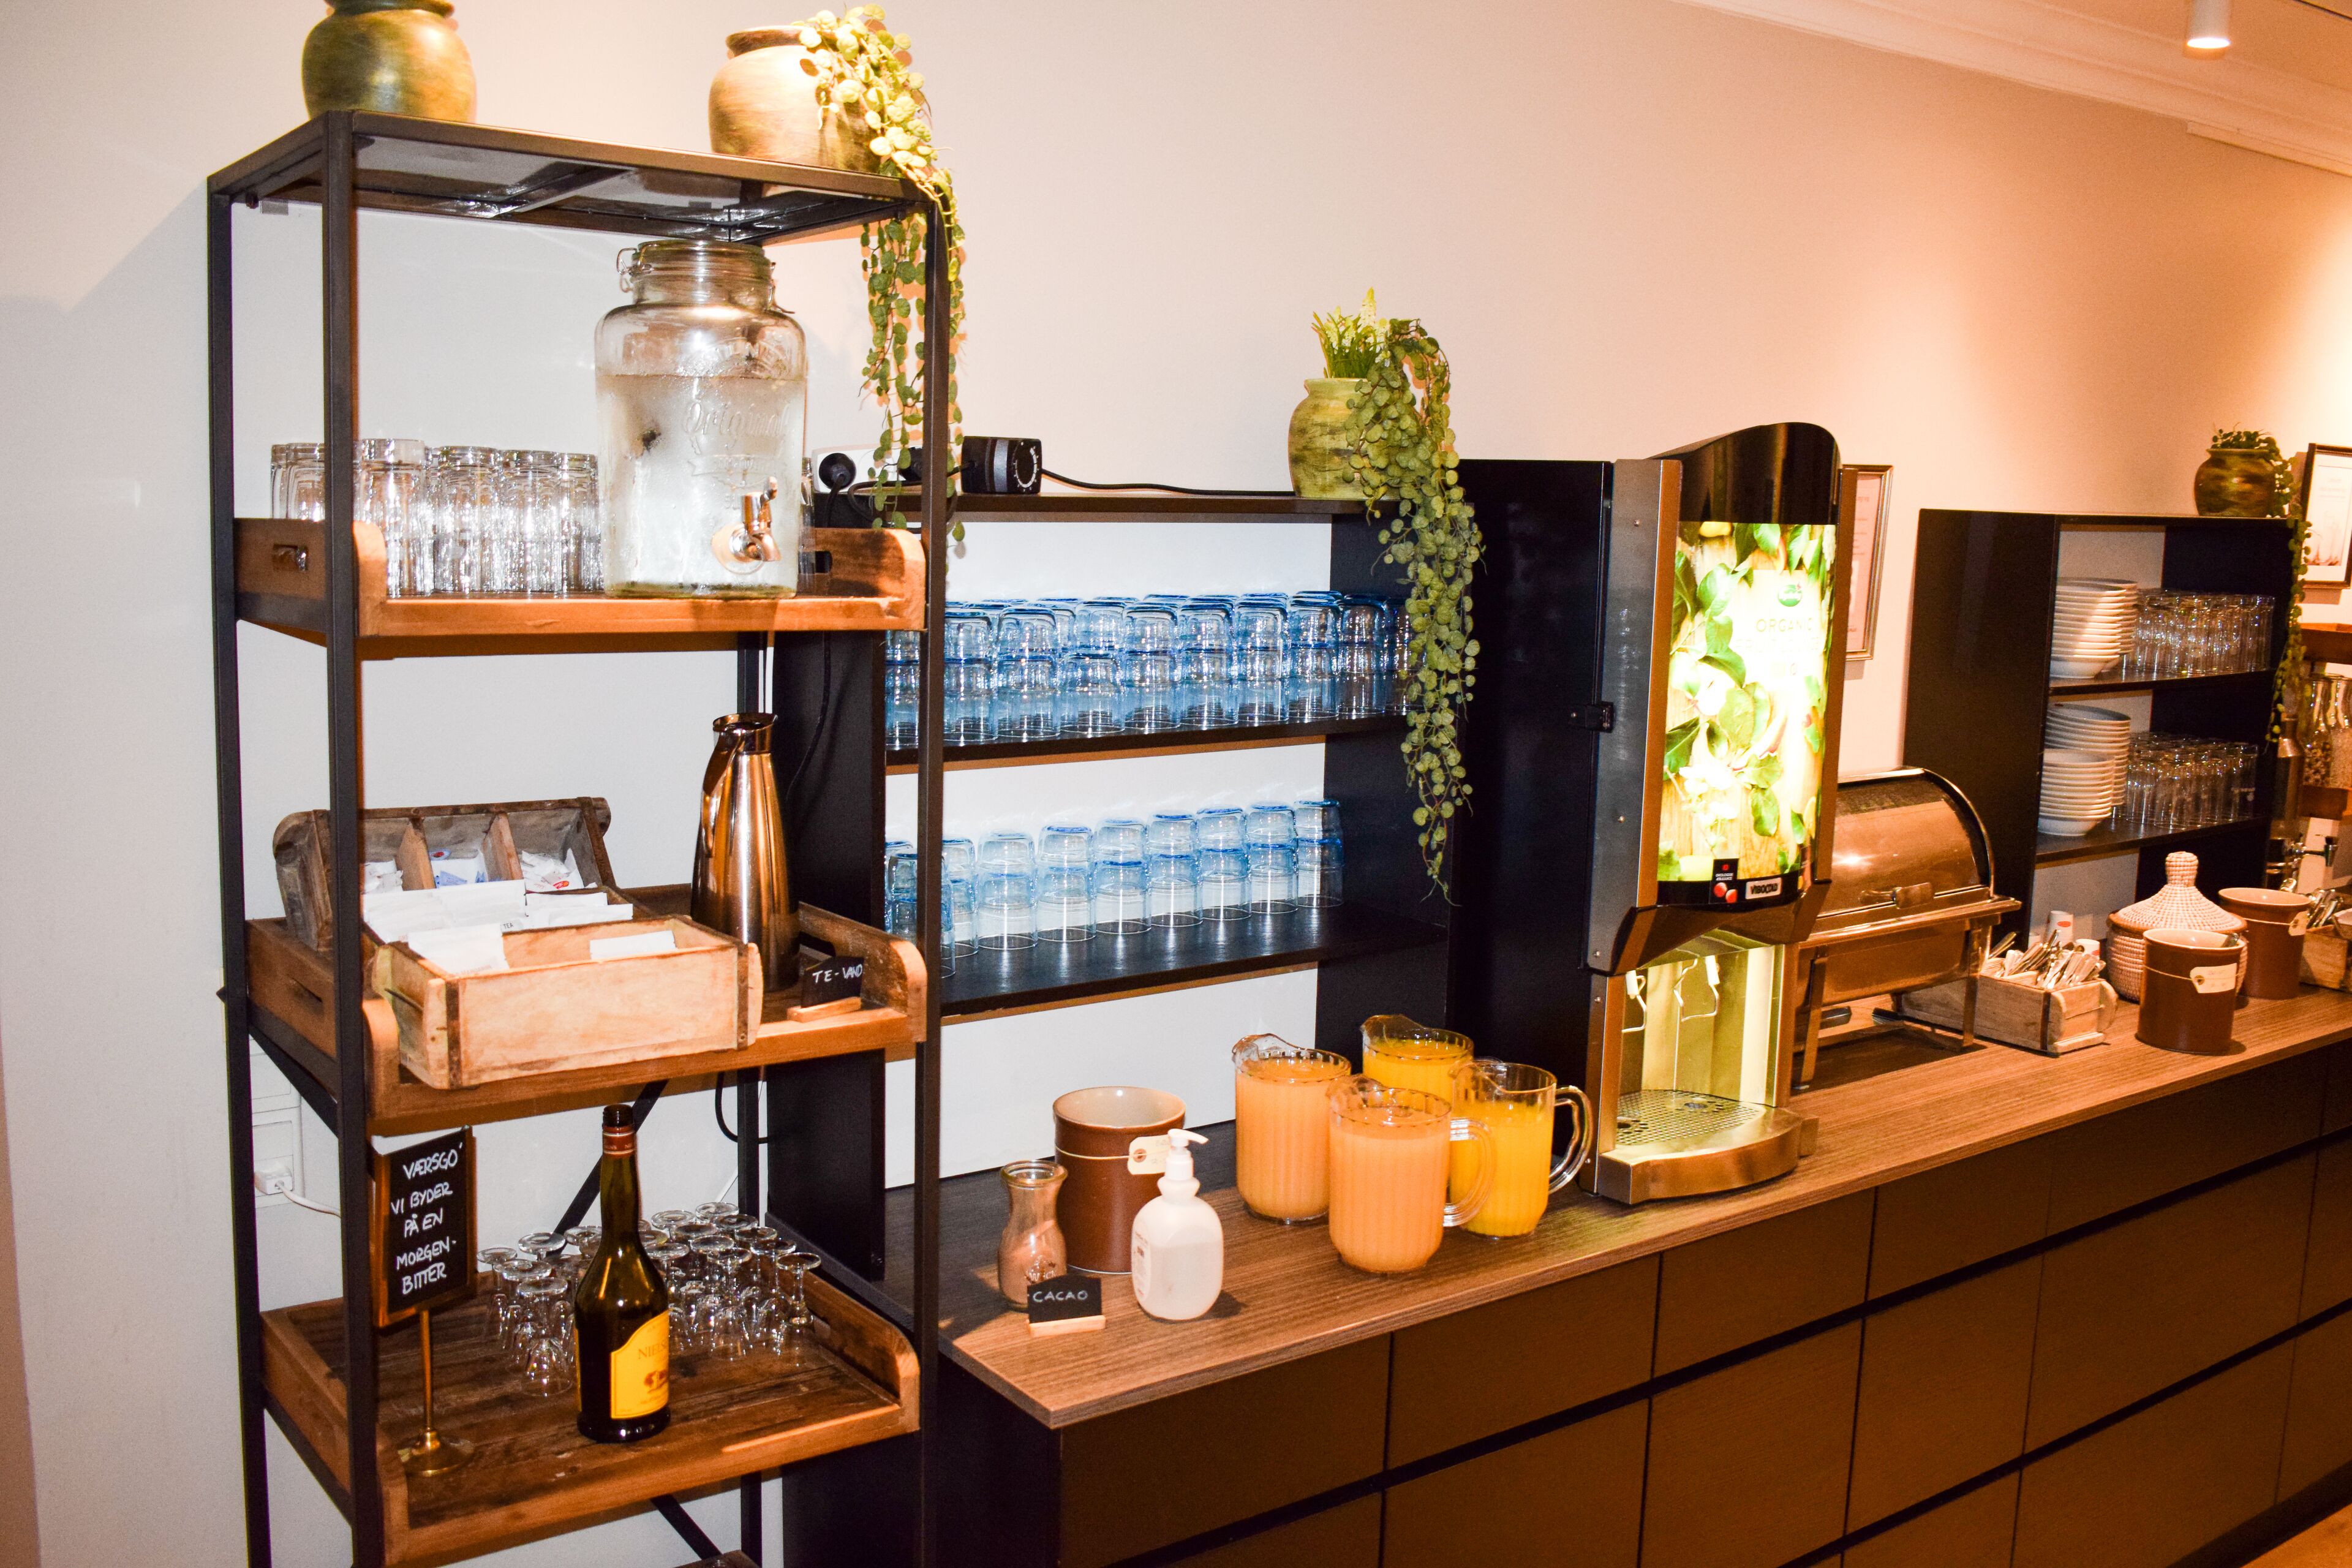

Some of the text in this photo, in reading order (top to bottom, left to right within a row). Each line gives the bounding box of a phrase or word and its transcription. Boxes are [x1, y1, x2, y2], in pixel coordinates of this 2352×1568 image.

[1755, 617, 1812, 633] ORGANIC
[390, 1182, 453, 1215] VI BYDER
[404, 1207, 443, 1238] PÅ EN
[401, 1262, 447, 1295] BITTER
[1033, 1290, 1088, 1303] CACAO
